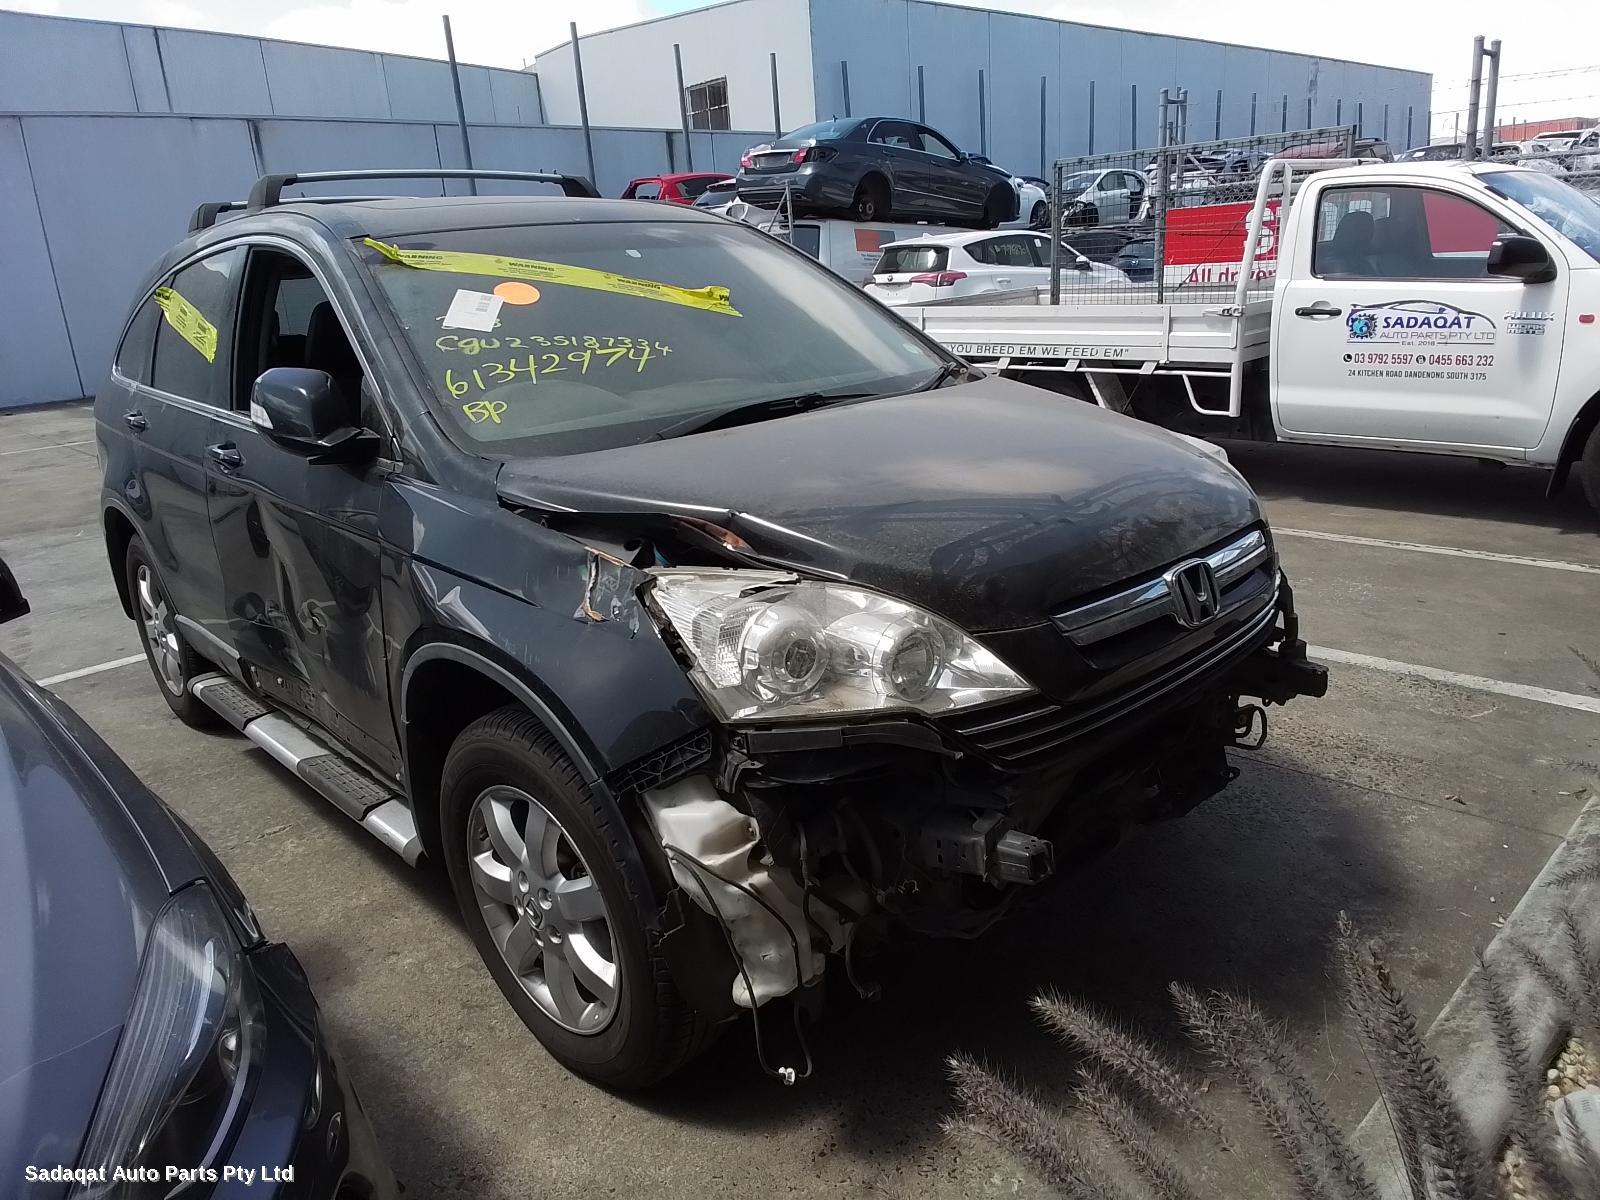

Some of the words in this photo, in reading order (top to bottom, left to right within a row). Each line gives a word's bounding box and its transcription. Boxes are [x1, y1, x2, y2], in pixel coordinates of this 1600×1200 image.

[1189, 267, 1212, 283] All
[1382, 315, 1476, 329] SADAQAT
[1379, 331, 1409, 340] AUTO
[1410, 331, 1447, 341] PARTS
[1448, 332, 1473, 341] PTY
[1474, 332, 1495, 341] LTD
[976, 345, 1015, 355] BREED
[1019, 346, 1037, 356] EM
[1041, 346, 1061, 356] WE
[1064, 347, 1099, 357] FEED
[1354, 353, 1365, 364] 03
[1367, 353, 1389, 365] 9792
[1391, 353, 1414, 365] 5597
[1428, 354, 1453, 366] 0455
[1455, 354, 1474, 366] 663
[1476, 355, 1495, 367] 232
[1347, 369, 1356, 377] 24
[1357, 369, 1384, 378] KITCHEN
[1385, 370, 1402, 378] ROAD
[1404, 370, 1445, 379] DANDENONG
[1446, 371, 1469, 380] SOUTH
[1470, 372, 1487, 381] 3175
